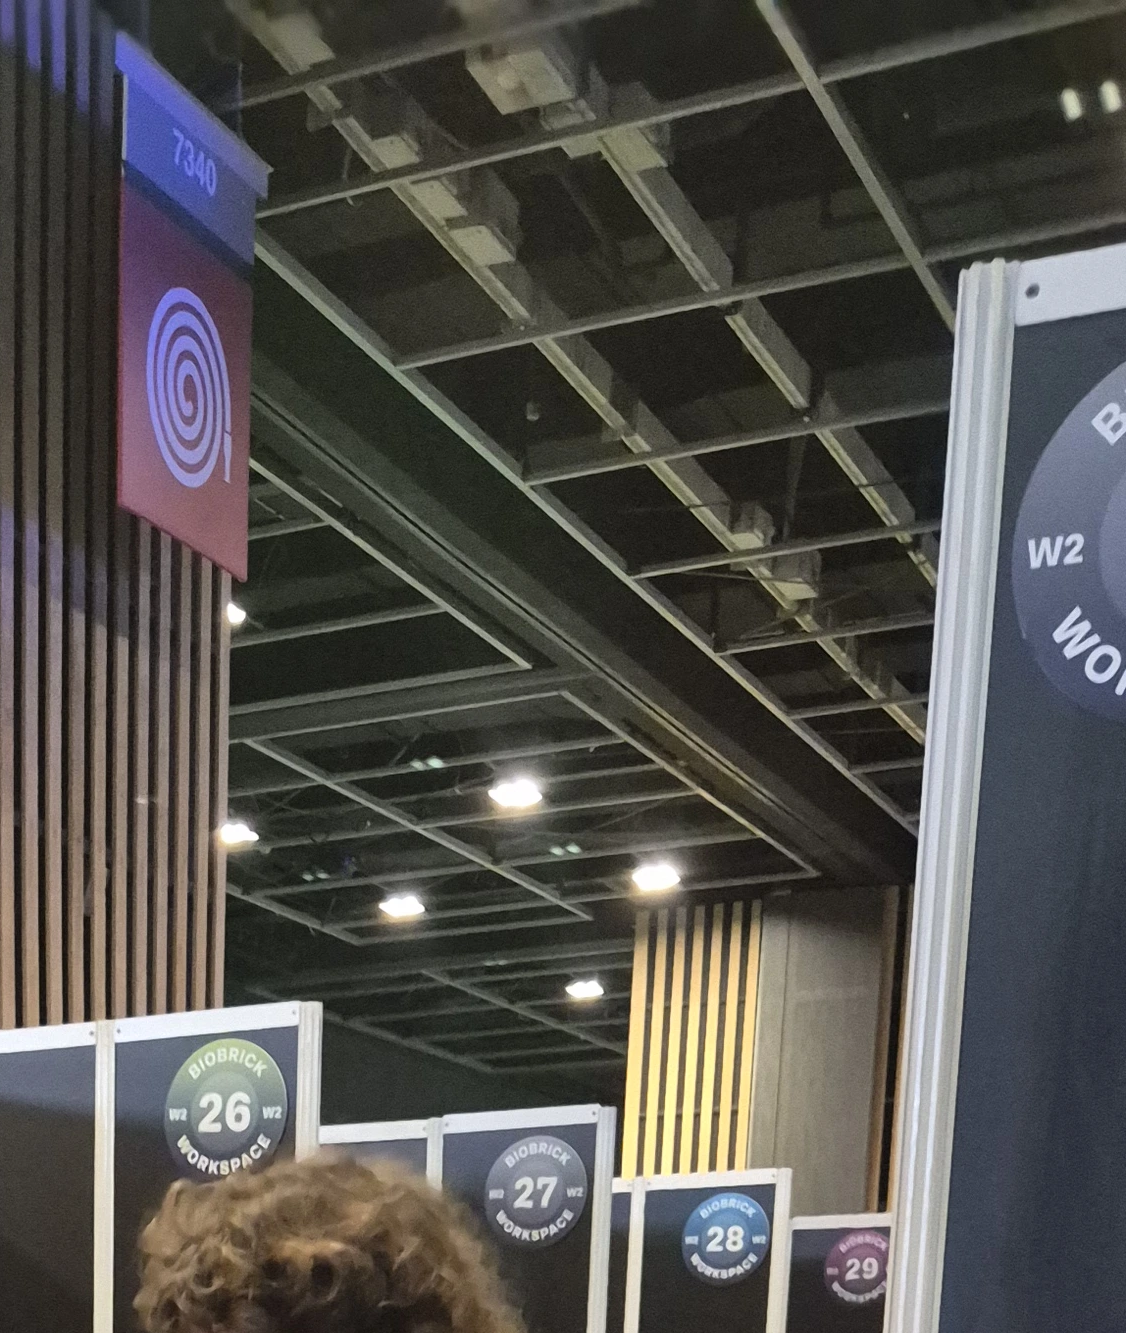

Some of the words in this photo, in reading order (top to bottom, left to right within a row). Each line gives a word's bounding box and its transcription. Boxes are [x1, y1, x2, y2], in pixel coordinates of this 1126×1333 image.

[173, 128, 217, 196] 7340
[1028, 533, 1085, 569] W2
[187, 1047, 268, 1080] BIOBRICK
[169, 1107, 188, 1122] W2
[197, 1091, 252, 1133] 26
[262, 1105, 282, 1120] W2
[177, 1133, 272, 1176] WORKSPACE
[504, 1142, 572, 1168] BIOBRICK
[513, 1176, 558, 1209] 27
[566, 1187, 584, 1198] W2
[700, 1198, 757, 1219] BIOBRICK
[496, 1208, 574, 1242] WORKSPACE
[706, 1225, 744, 1252] 28
[845, 1257, 878, 1281] 29
